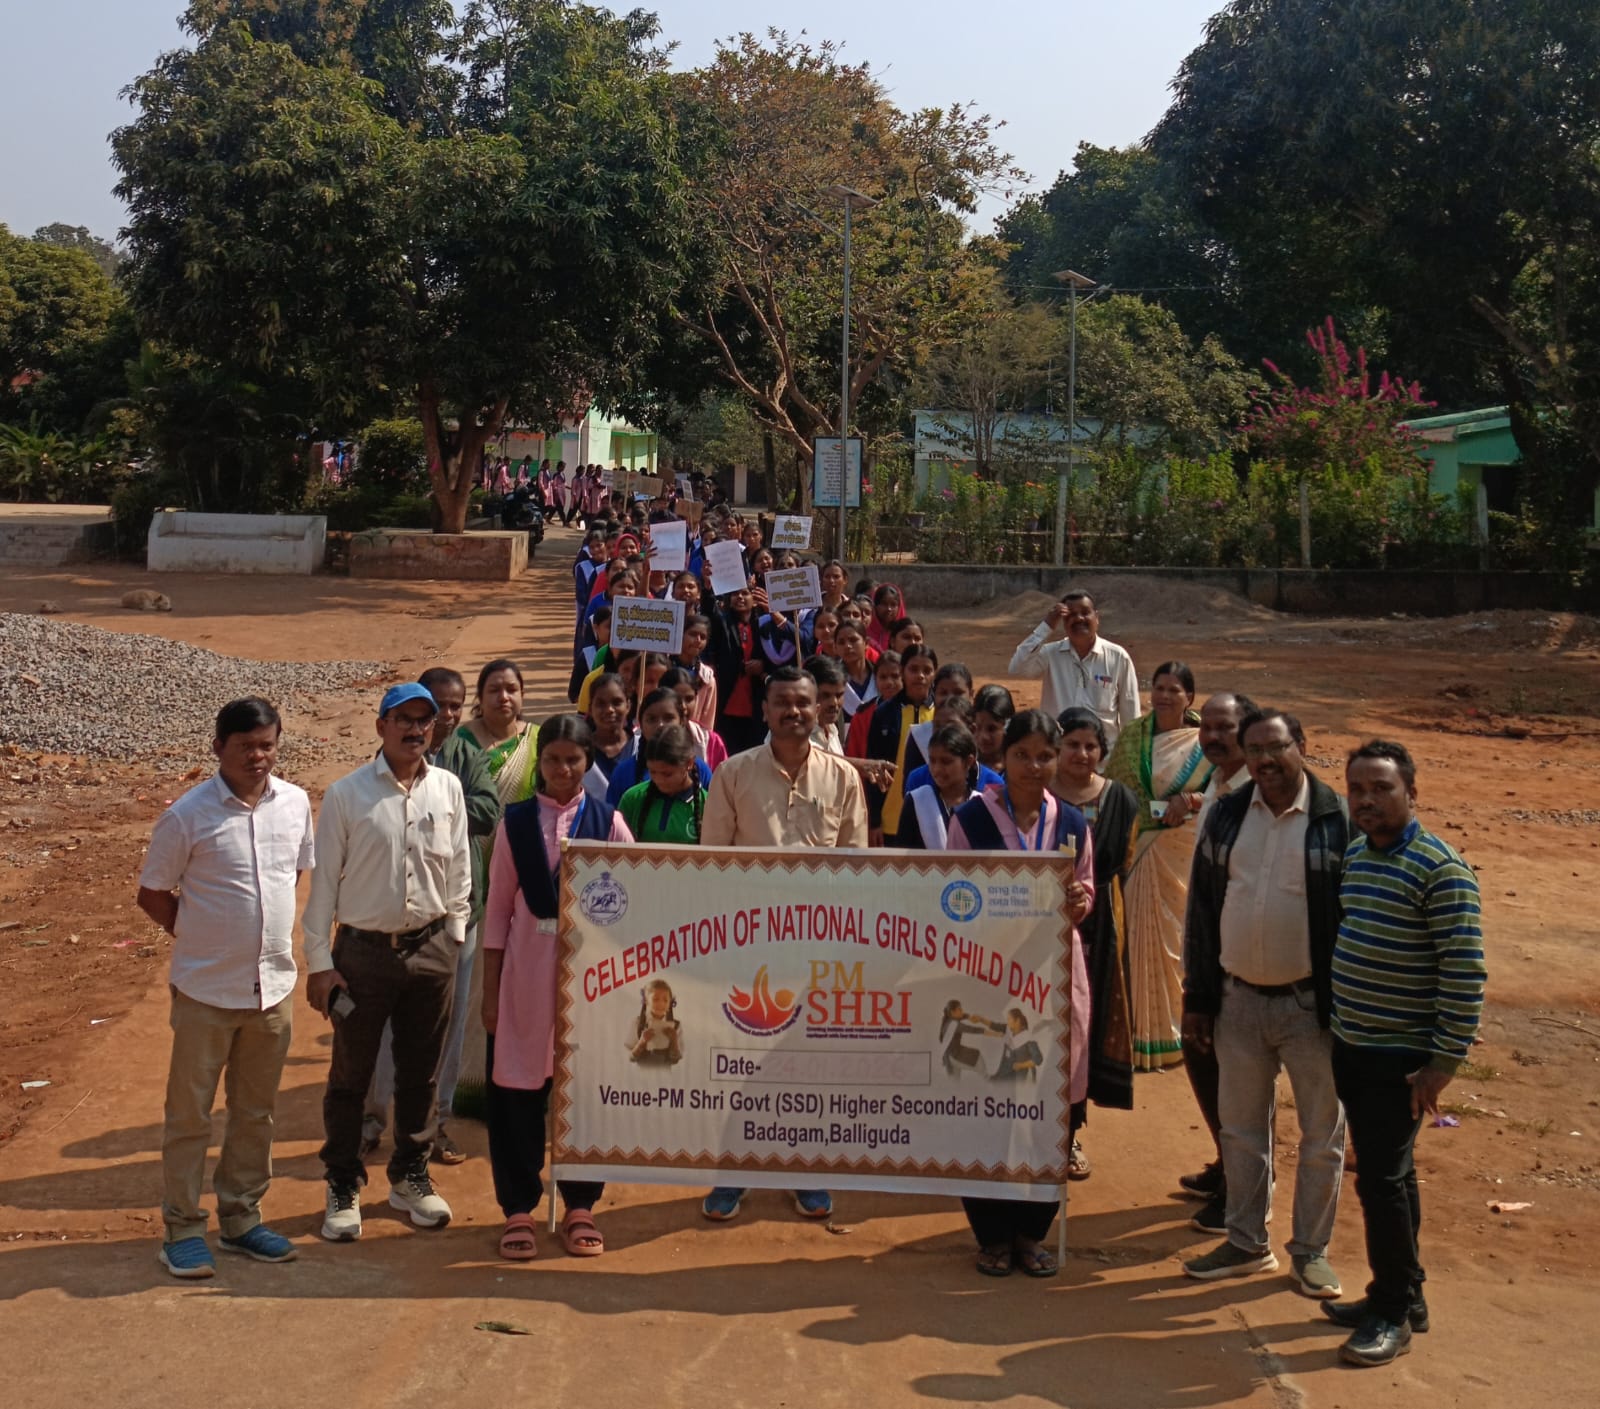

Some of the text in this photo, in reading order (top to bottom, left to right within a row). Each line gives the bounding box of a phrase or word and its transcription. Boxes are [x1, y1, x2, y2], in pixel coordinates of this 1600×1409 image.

[583, 904, 1052, 1015] CELEBRATION OF NATIONAL GIRLS CHILD DAY
[807, 959, 865, 991] PM
[806, 990, 912, 1026] SHRI
[716, 1054, 762, 1076] Date-
[599, 1084, 1045, 1122] Venue-PM Shri Govt (SSD) Higher Secondari School
[743, 1120, 911, 1150] Badagam,Balliguda
